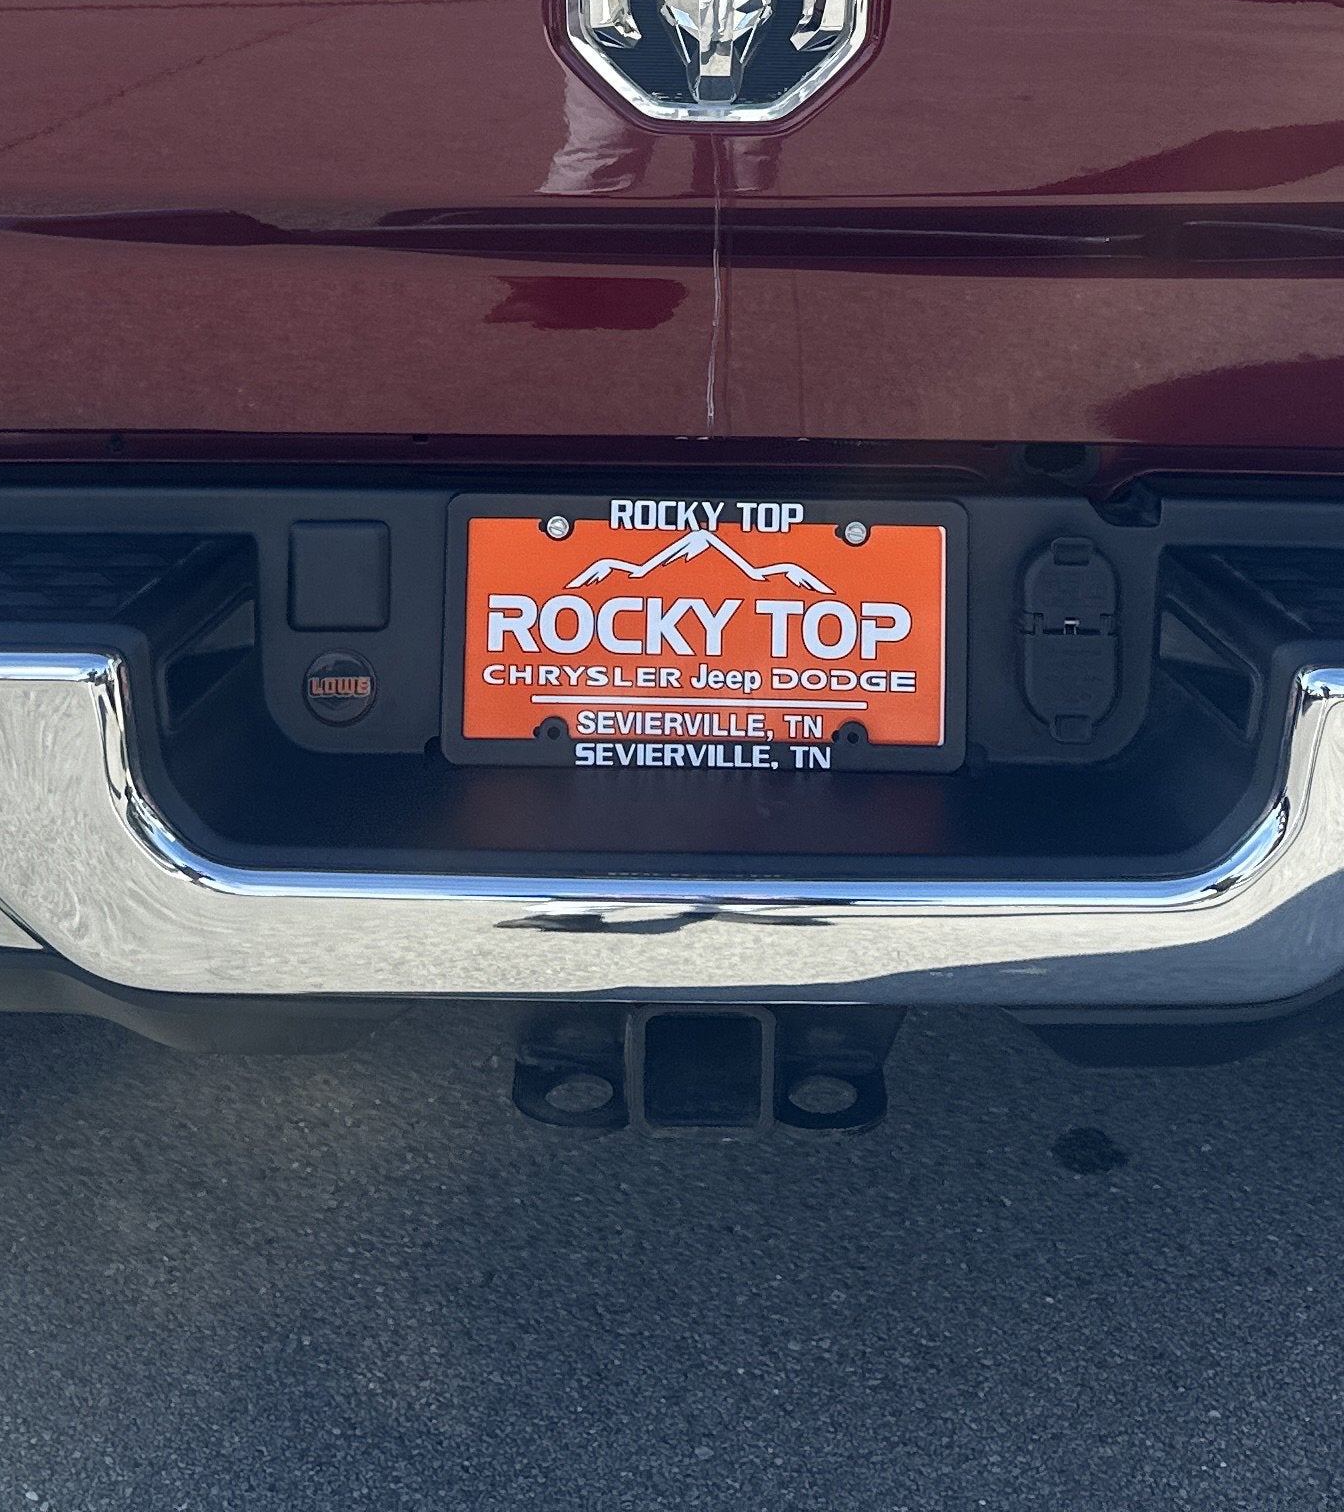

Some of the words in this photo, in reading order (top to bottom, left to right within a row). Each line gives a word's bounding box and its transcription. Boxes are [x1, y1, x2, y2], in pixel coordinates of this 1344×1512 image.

[610, 499, 725, 531] ROCKY
[736, 501, 805, 533] TOP
[487, 593, 745, 656] ROCKY
[754, 598, 913, 661] TOP
[482, 663, 682, 688] CHRYSLER
[690, 663, 762, 694] Jeep
[771, 667, 917, 693] DODGE
[576, 709, 774, 742] SEVIERVILLE,
[783, 713, 824, 739] TN
[574, 742, 779, 770] SEVIERVILLE,
[789, 745, 832, 770] TN
